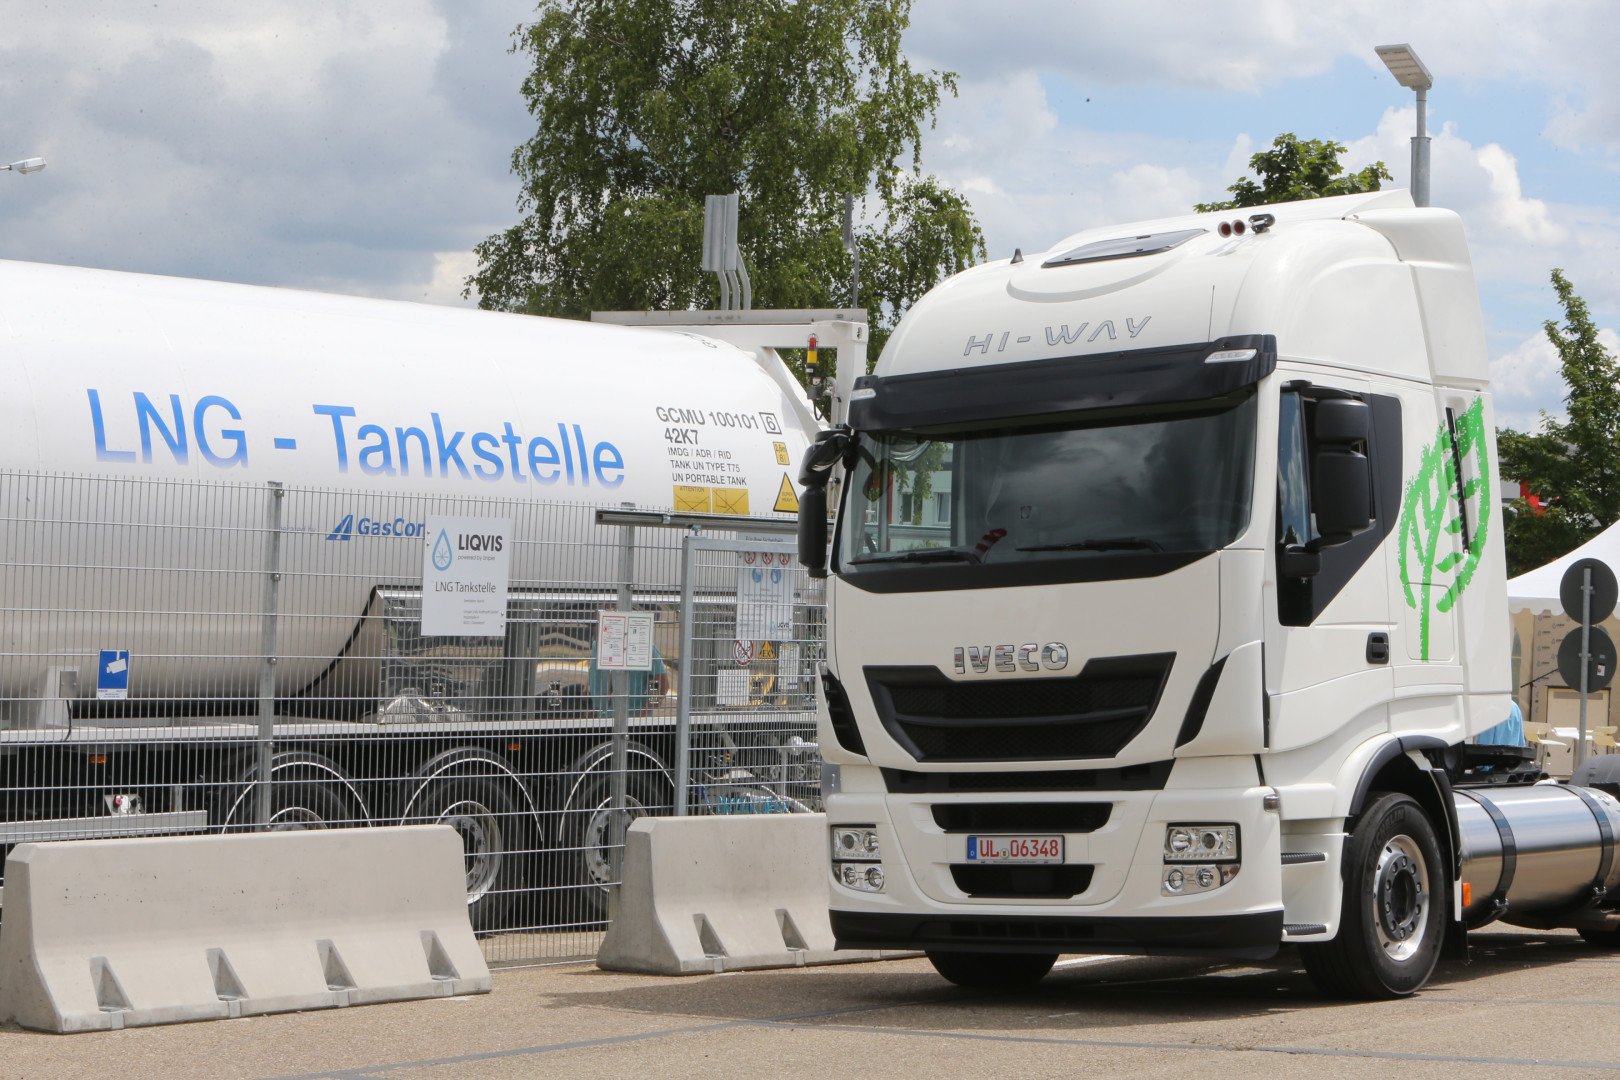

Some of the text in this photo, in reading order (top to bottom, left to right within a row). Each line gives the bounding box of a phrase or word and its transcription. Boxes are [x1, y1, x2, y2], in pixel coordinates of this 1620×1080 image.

[656, 407, 775, 431] GCMU 100101 6
[87, 388, 625, 488] LNG - Tankstelle
[664, 428, 698, 444] 42K7
[668, 447, 689, 457] IMDG
[696, 449, 712, 458] ADR
[718, 450, 731, 459] RID
[670, 460, 740, 473] TANK UN TYPE T75
[672, 473, 747, 486] UN PORTABLE TANK
[458, 534, 503, 552] LIQVIS
[435, 581, 497, 593] LNG Tankstelle
[953, 642, 1068, 674] IVECO
[980, 840, 999, 857] UL
[1010, 840, 1058, 857] 06348
